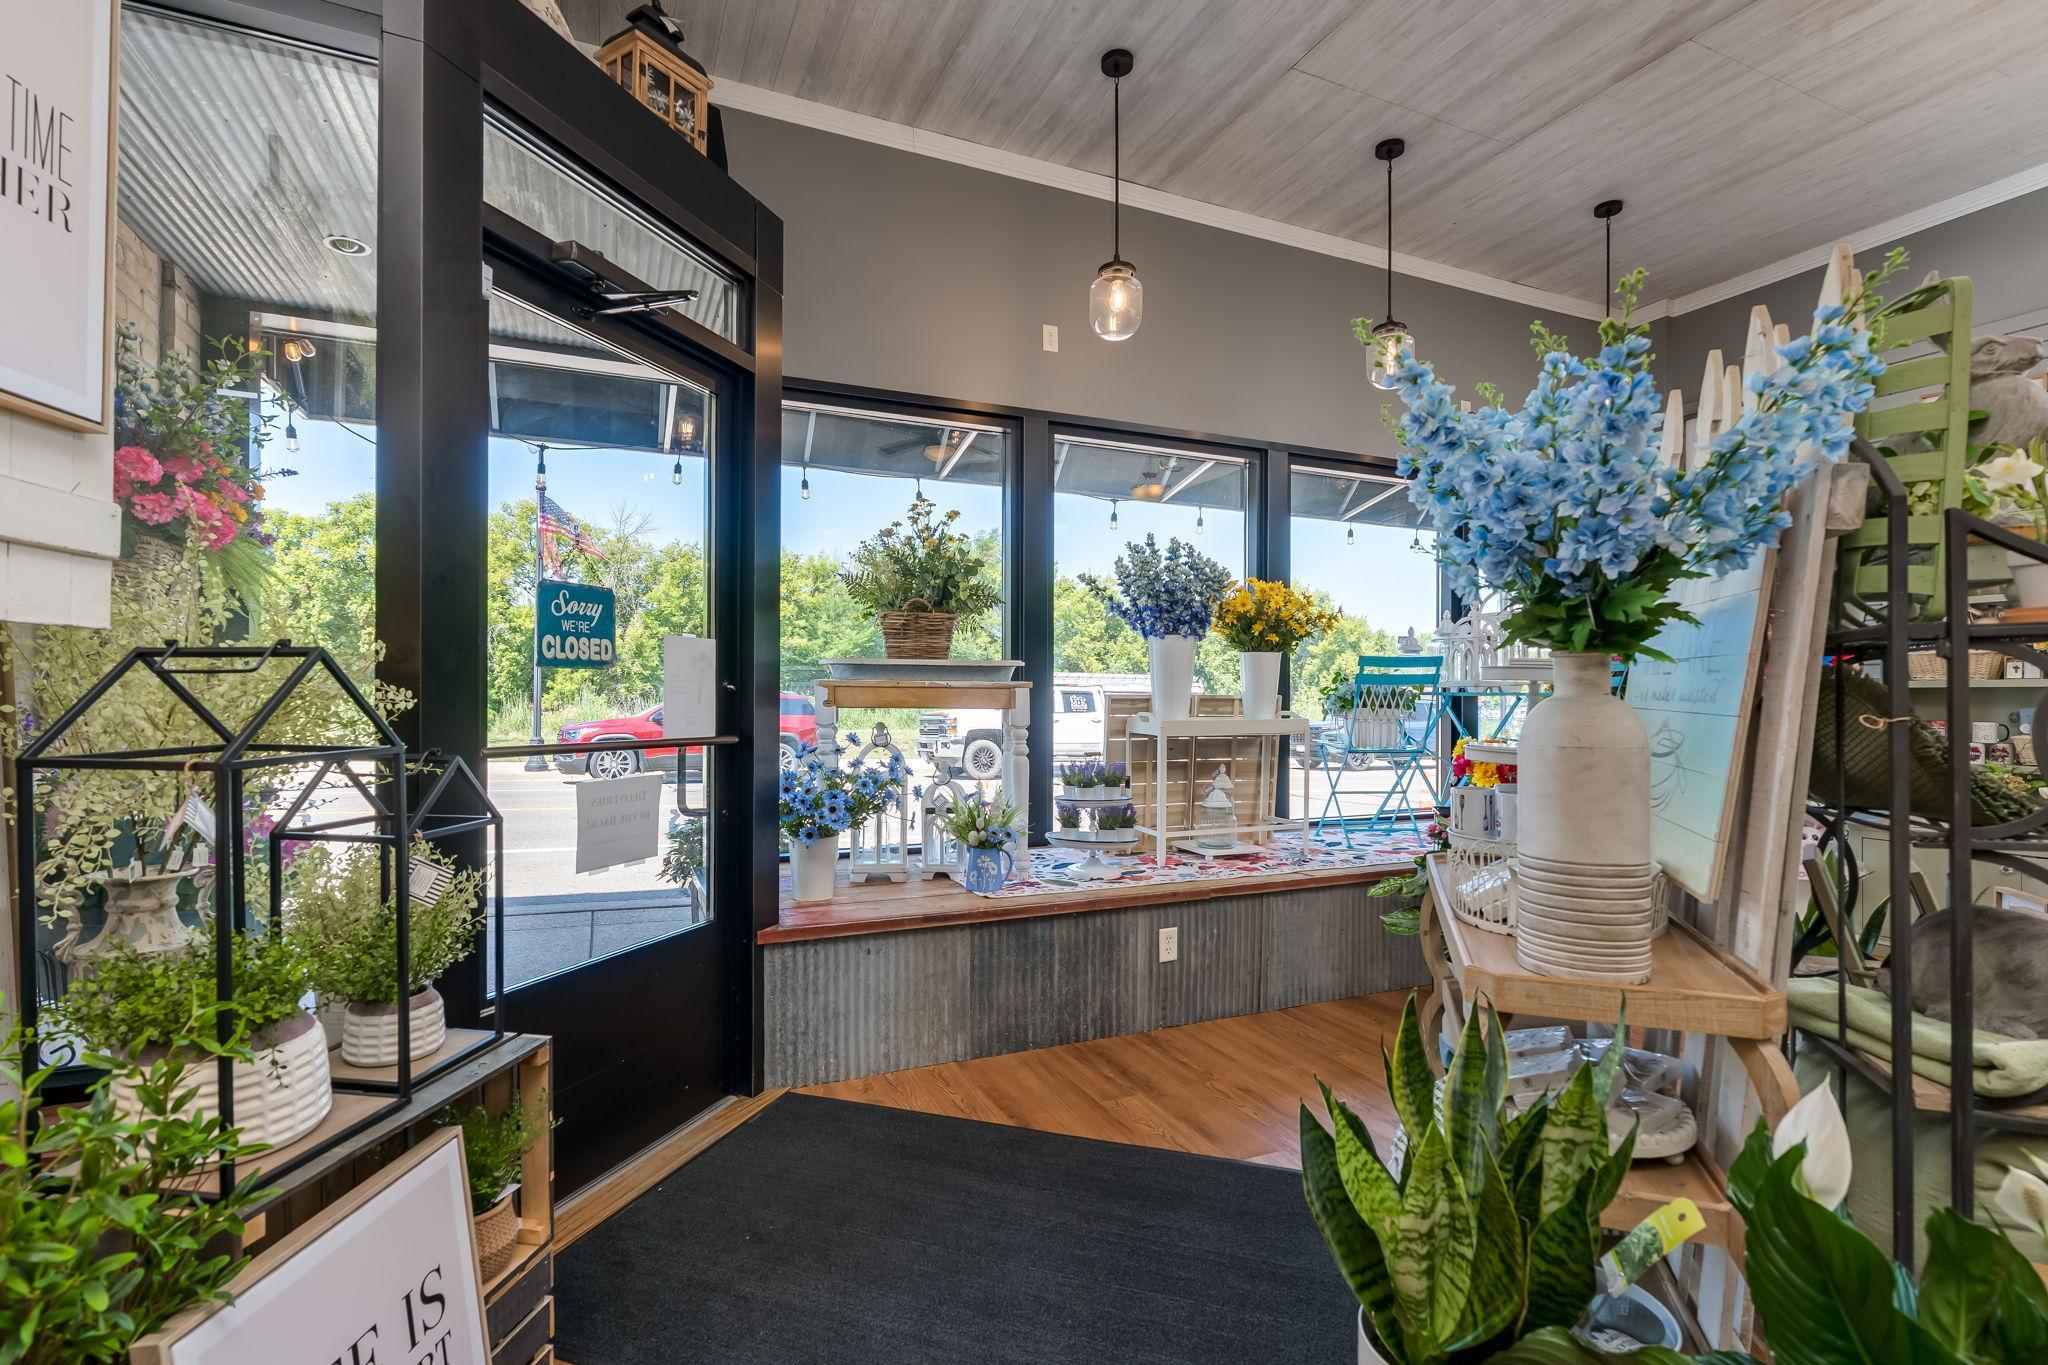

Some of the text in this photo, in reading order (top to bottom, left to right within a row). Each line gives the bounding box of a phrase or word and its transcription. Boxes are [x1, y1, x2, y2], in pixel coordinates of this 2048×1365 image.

[6, 74, 74, 187] TIME
[551, 590, 603, 628] Sorry
[561, 619, 591, 633] WE'RE
[541, 634, 613, 660] CLOSED
[401, 1263, 446, 1353] IS
